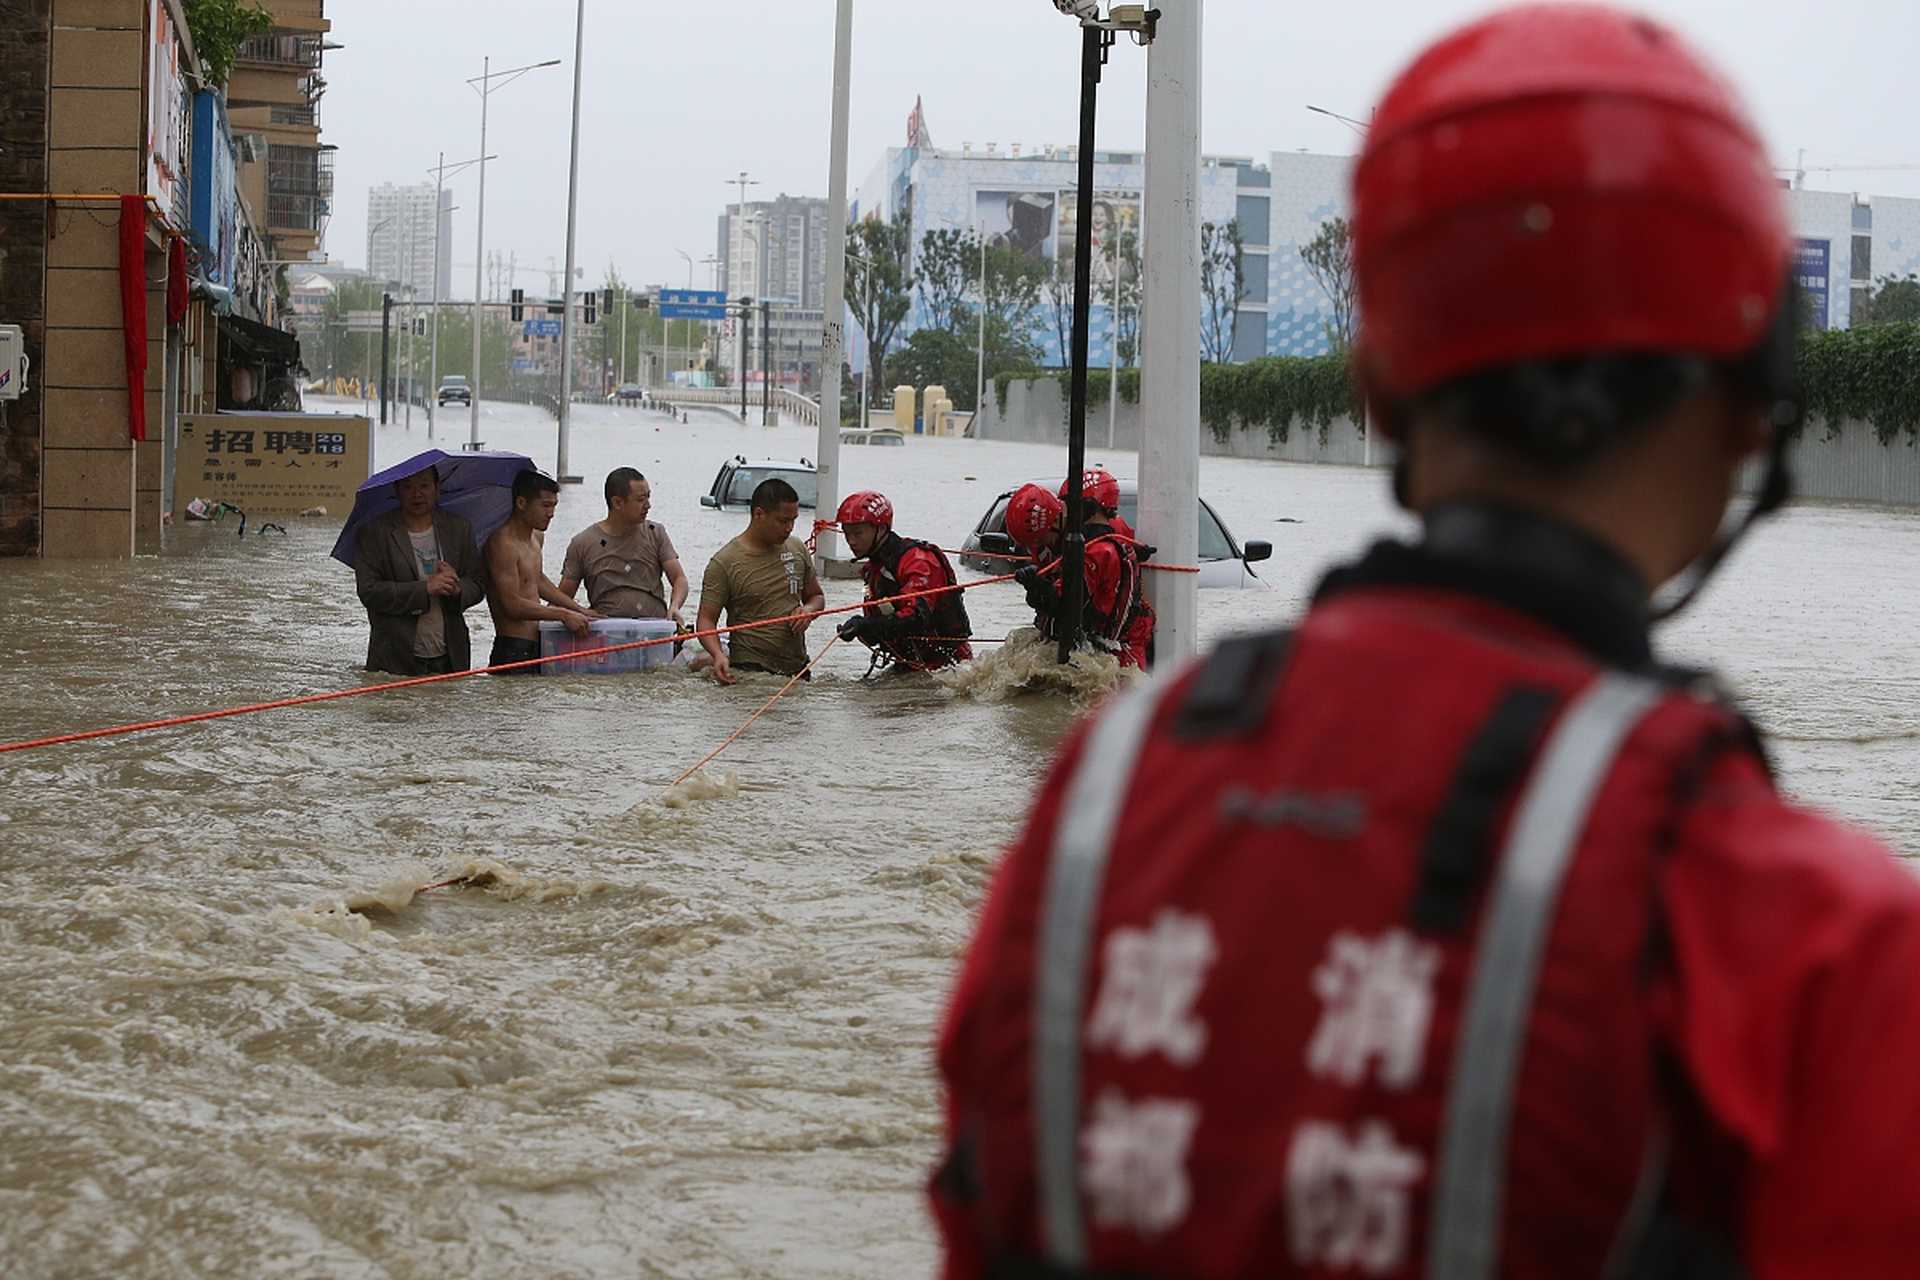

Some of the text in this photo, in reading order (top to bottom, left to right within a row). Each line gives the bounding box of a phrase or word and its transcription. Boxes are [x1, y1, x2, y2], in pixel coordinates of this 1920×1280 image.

[205, 429, 313, 455] 招聘
[317, 434, 343, 443] 20
[319, 446, 343, 454] 18
